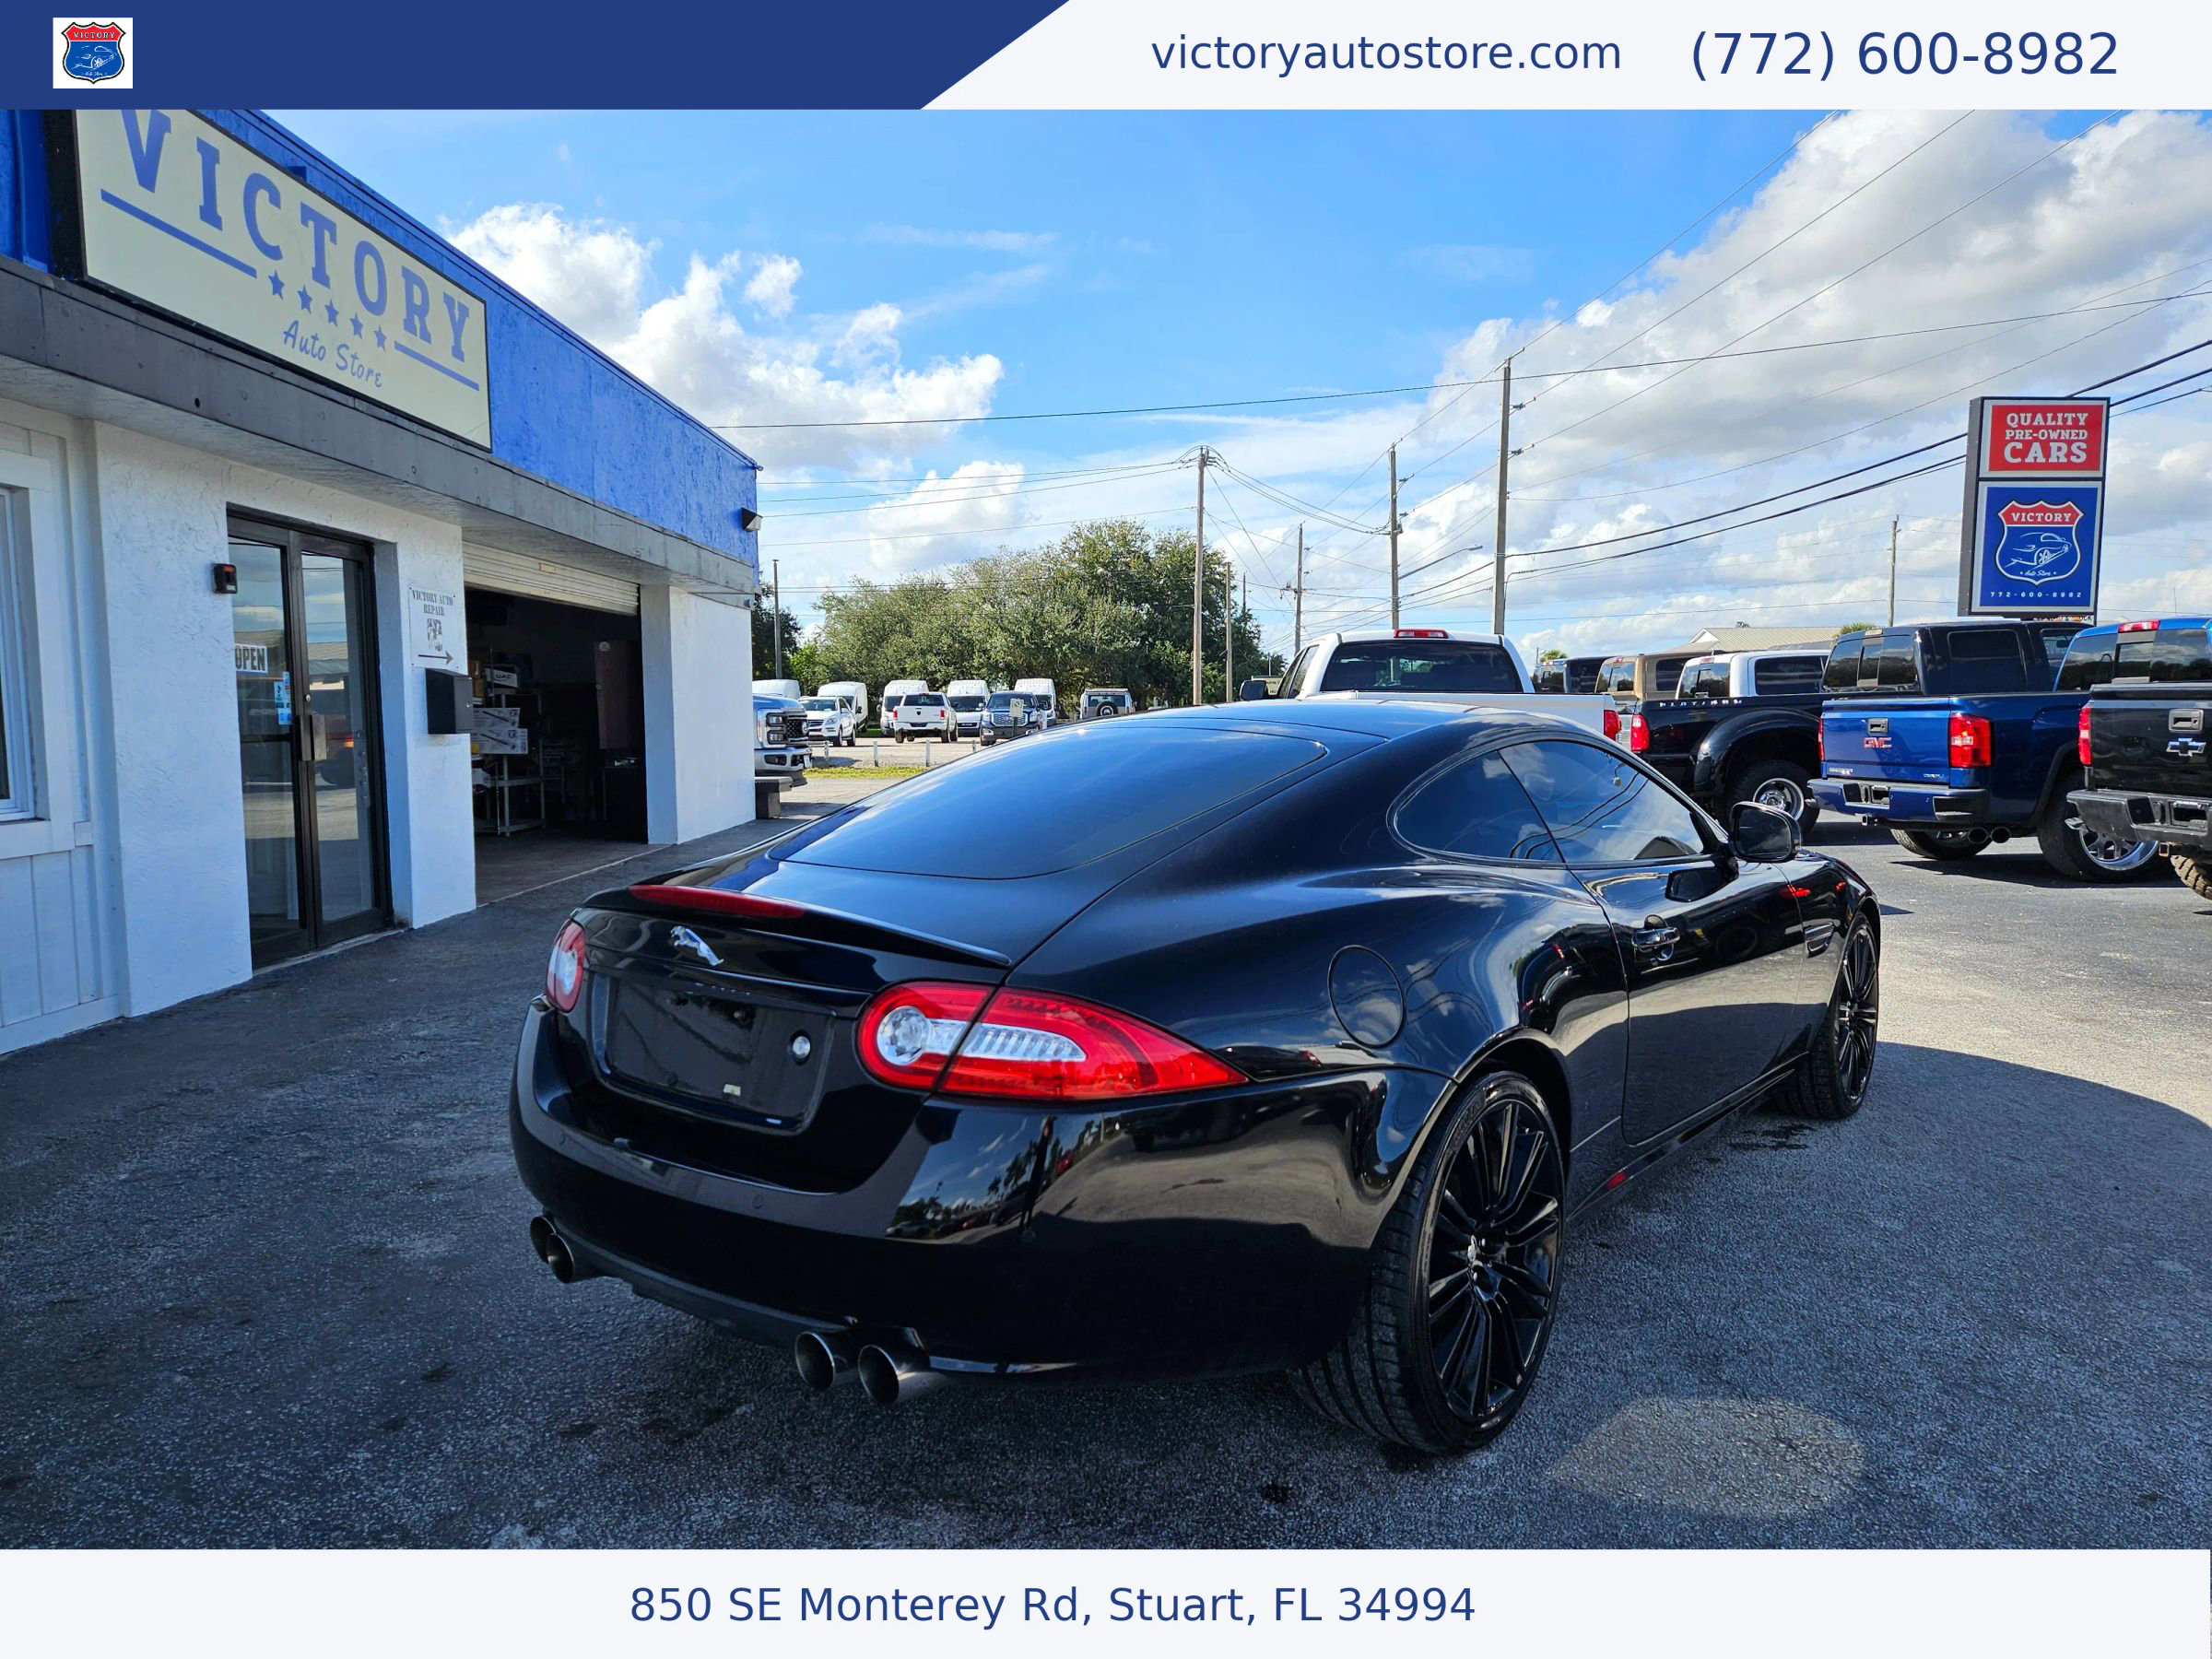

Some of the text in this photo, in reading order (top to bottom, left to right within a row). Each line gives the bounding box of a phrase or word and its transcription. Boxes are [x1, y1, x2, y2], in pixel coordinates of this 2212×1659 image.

[121, 110, 469, 362] VICTORY
[284, 320, 382, 387] Auto Store
[2006, 413, 2088, 428] QUALITY
[2006, 429, 2088, 440] PRE-OWNED
[2004, 441, 2088, 463] CARS
[2011, 512, 2072, 522] VICTORY
[412, 590, 453, 606] VICTORY AUTO
[423, 604, 445, 616] REPAIR
[235, 645, 265, 671] OPEN
[1864, 736, 1892, 748] GMC
